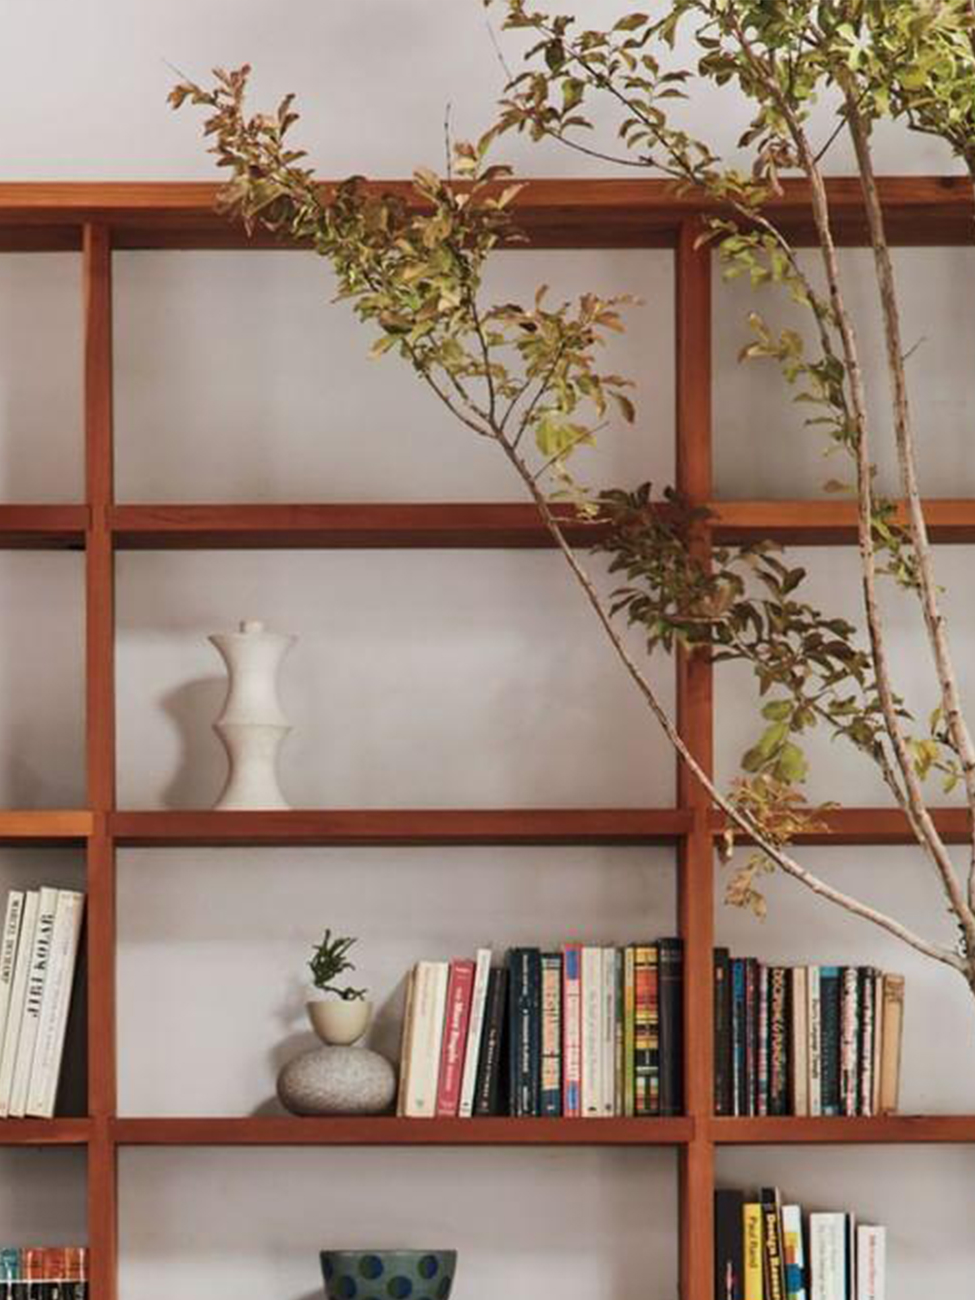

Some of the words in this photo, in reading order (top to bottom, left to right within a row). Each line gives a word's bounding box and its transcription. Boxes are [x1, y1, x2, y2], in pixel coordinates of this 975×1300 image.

[749, 1216, 758, 1239] Paul
[766, 1214, 779, 1255] Design
[749, 1240, 758, 1269] Rand
